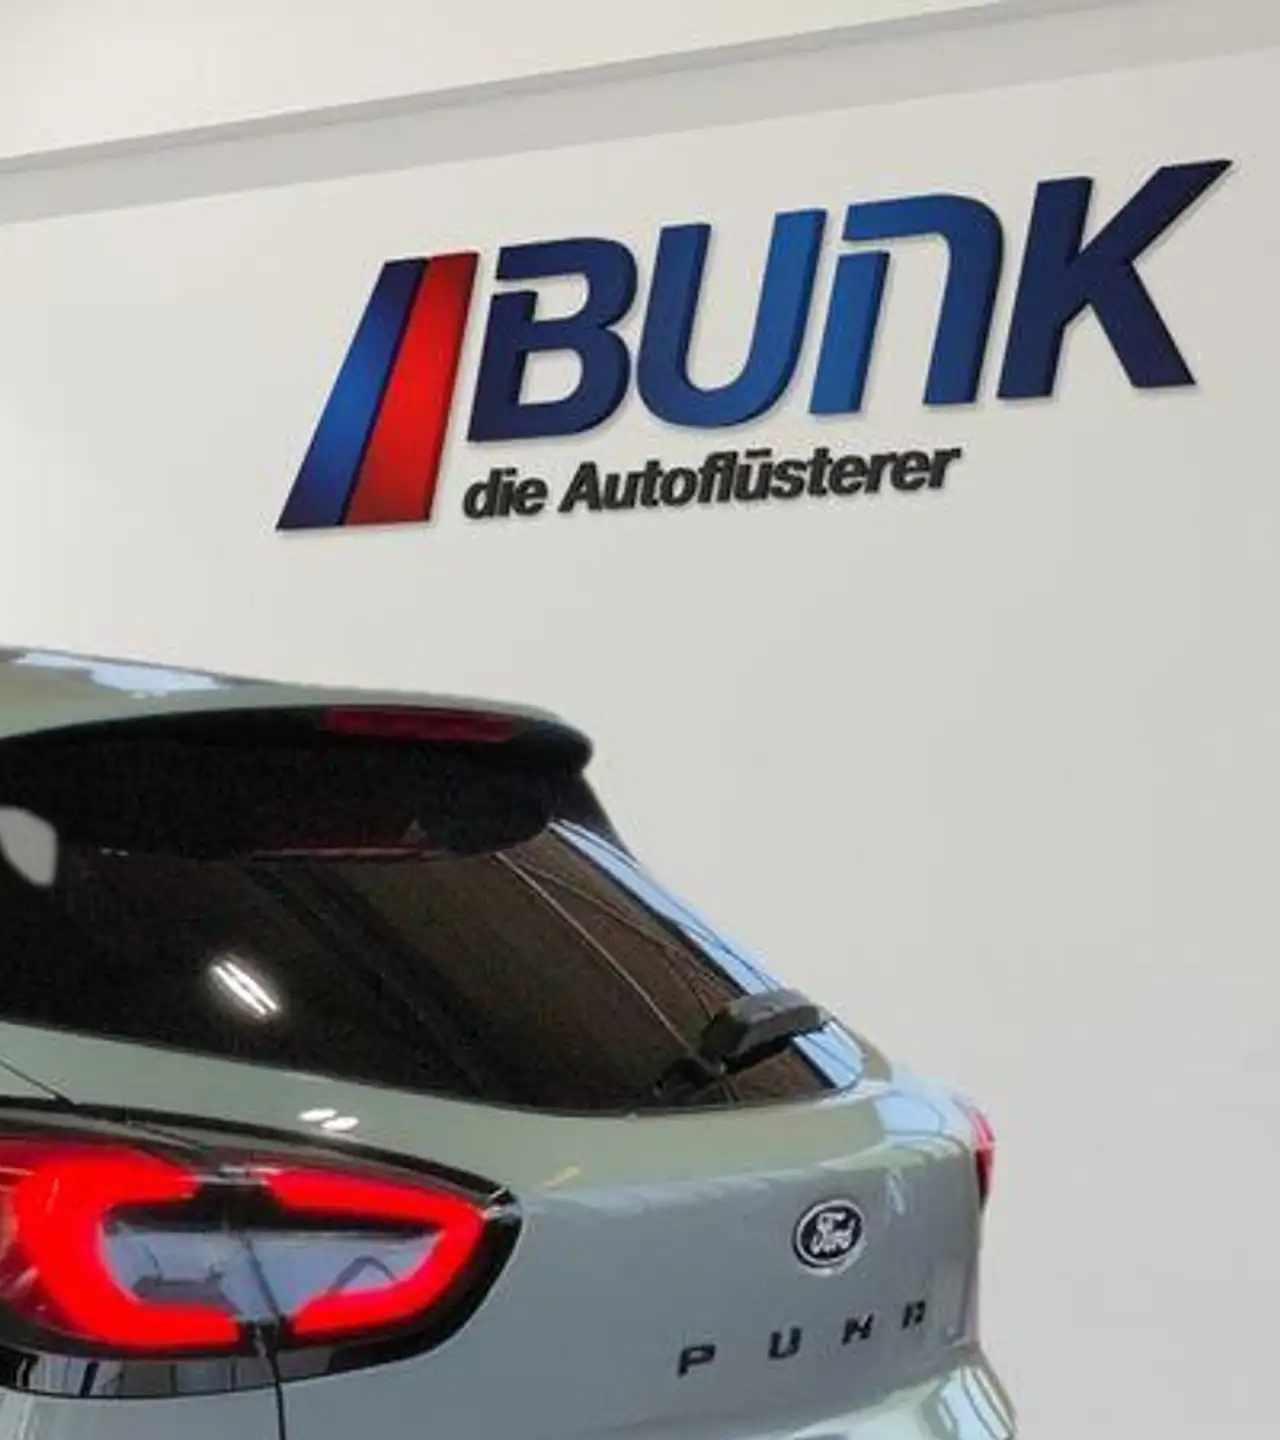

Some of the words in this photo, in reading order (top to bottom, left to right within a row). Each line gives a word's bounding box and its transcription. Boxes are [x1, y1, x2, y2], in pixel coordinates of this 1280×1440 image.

[467, 158, 1233, 443] BUNK
[462, 467, 549, 520] die
[558, 444, 963, 515] Autoflüsterer
[809, 1210, 858, 1256] Ford
